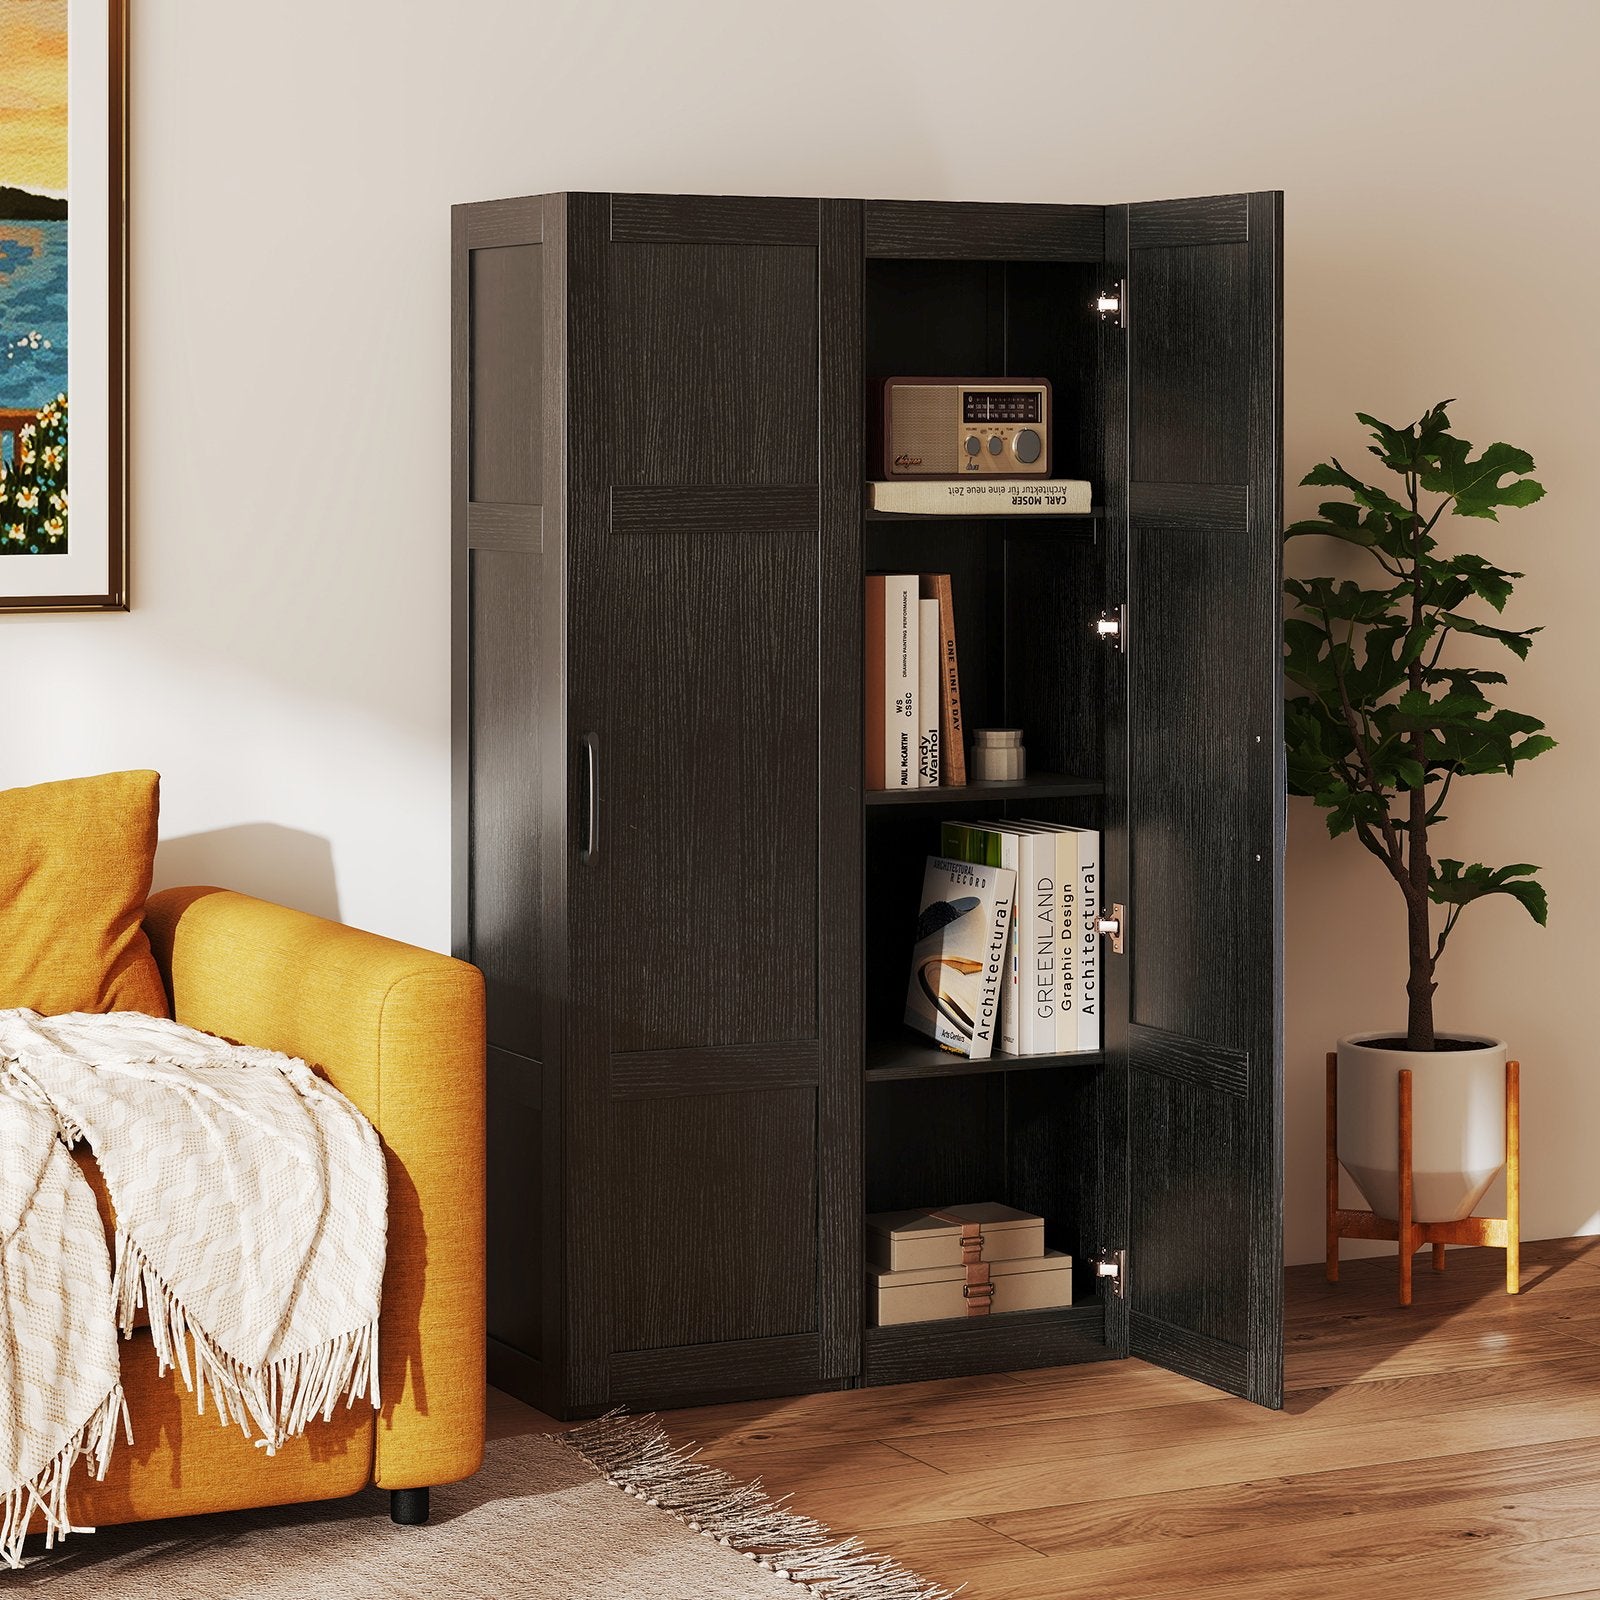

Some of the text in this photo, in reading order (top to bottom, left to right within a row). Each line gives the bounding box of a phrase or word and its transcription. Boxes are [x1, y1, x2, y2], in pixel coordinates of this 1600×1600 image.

[948, 485, 1067, 496] Architektur für eine neue Zeit
[1011, 496, 1067, 505] CARL MOSER
[896, 699, 903, 714] WS
[947, 640, 960, 731] ONE LINE A DAY
[919, 736, 931, 777] Andy
[929, 729, 938, 783] Warhol
[934, 860, 975, 876] ARCHITECTURAL
[950, 872, 986, 889] RECORD
[1038, 877, 1054, 1018] GREENLAND
[1061, 884, 1075, 1011] Graphic Design
[1082, 862, 1095, 1015] Architectural
[977, 899, 1009, 1041] Architectural
